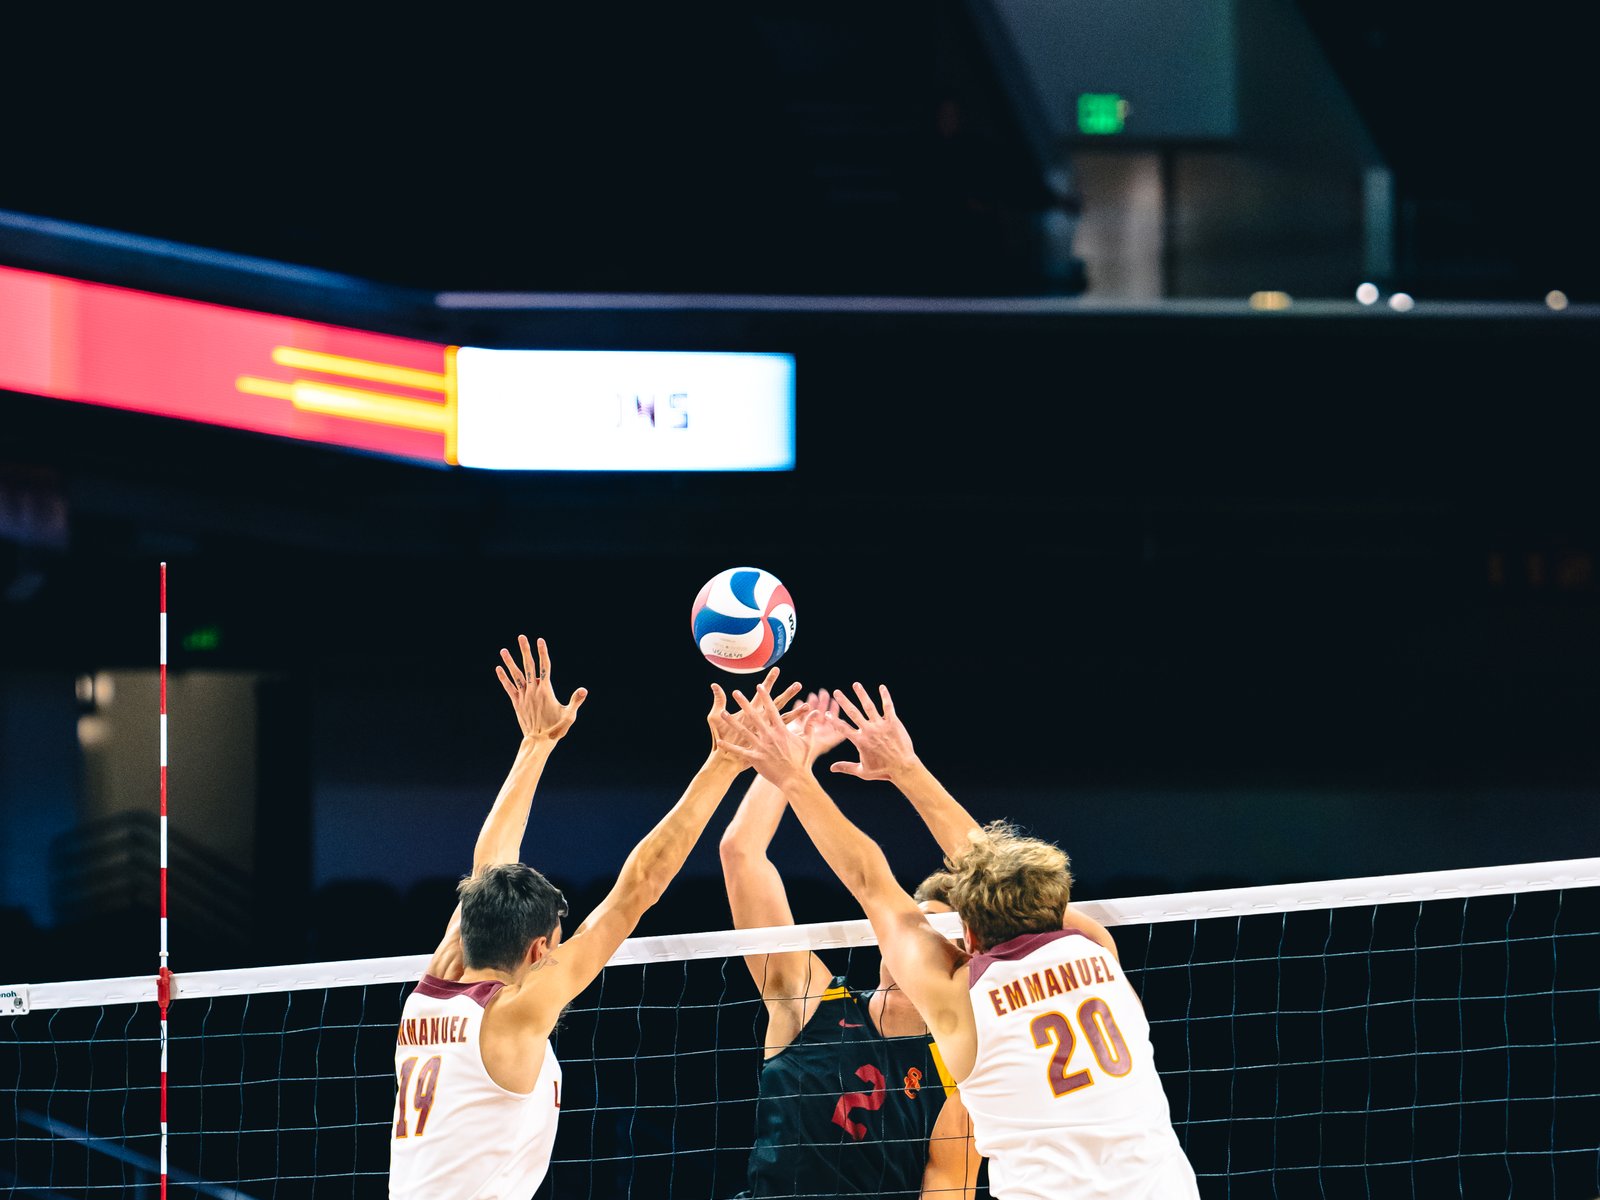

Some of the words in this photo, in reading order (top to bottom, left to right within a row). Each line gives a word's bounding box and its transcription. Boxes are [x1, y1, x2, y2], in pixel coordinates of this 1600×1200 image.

[0, 990, 17, 998] noh
[988, 956, 1115, 1017] EMMANUEL
[397, 1016, 469, 1046] MMANUEL
[1029, 997, 1133, 1099] 20
[396, 1055, 442, 1139] 19
[832, 1063, 887, 1141] 2
